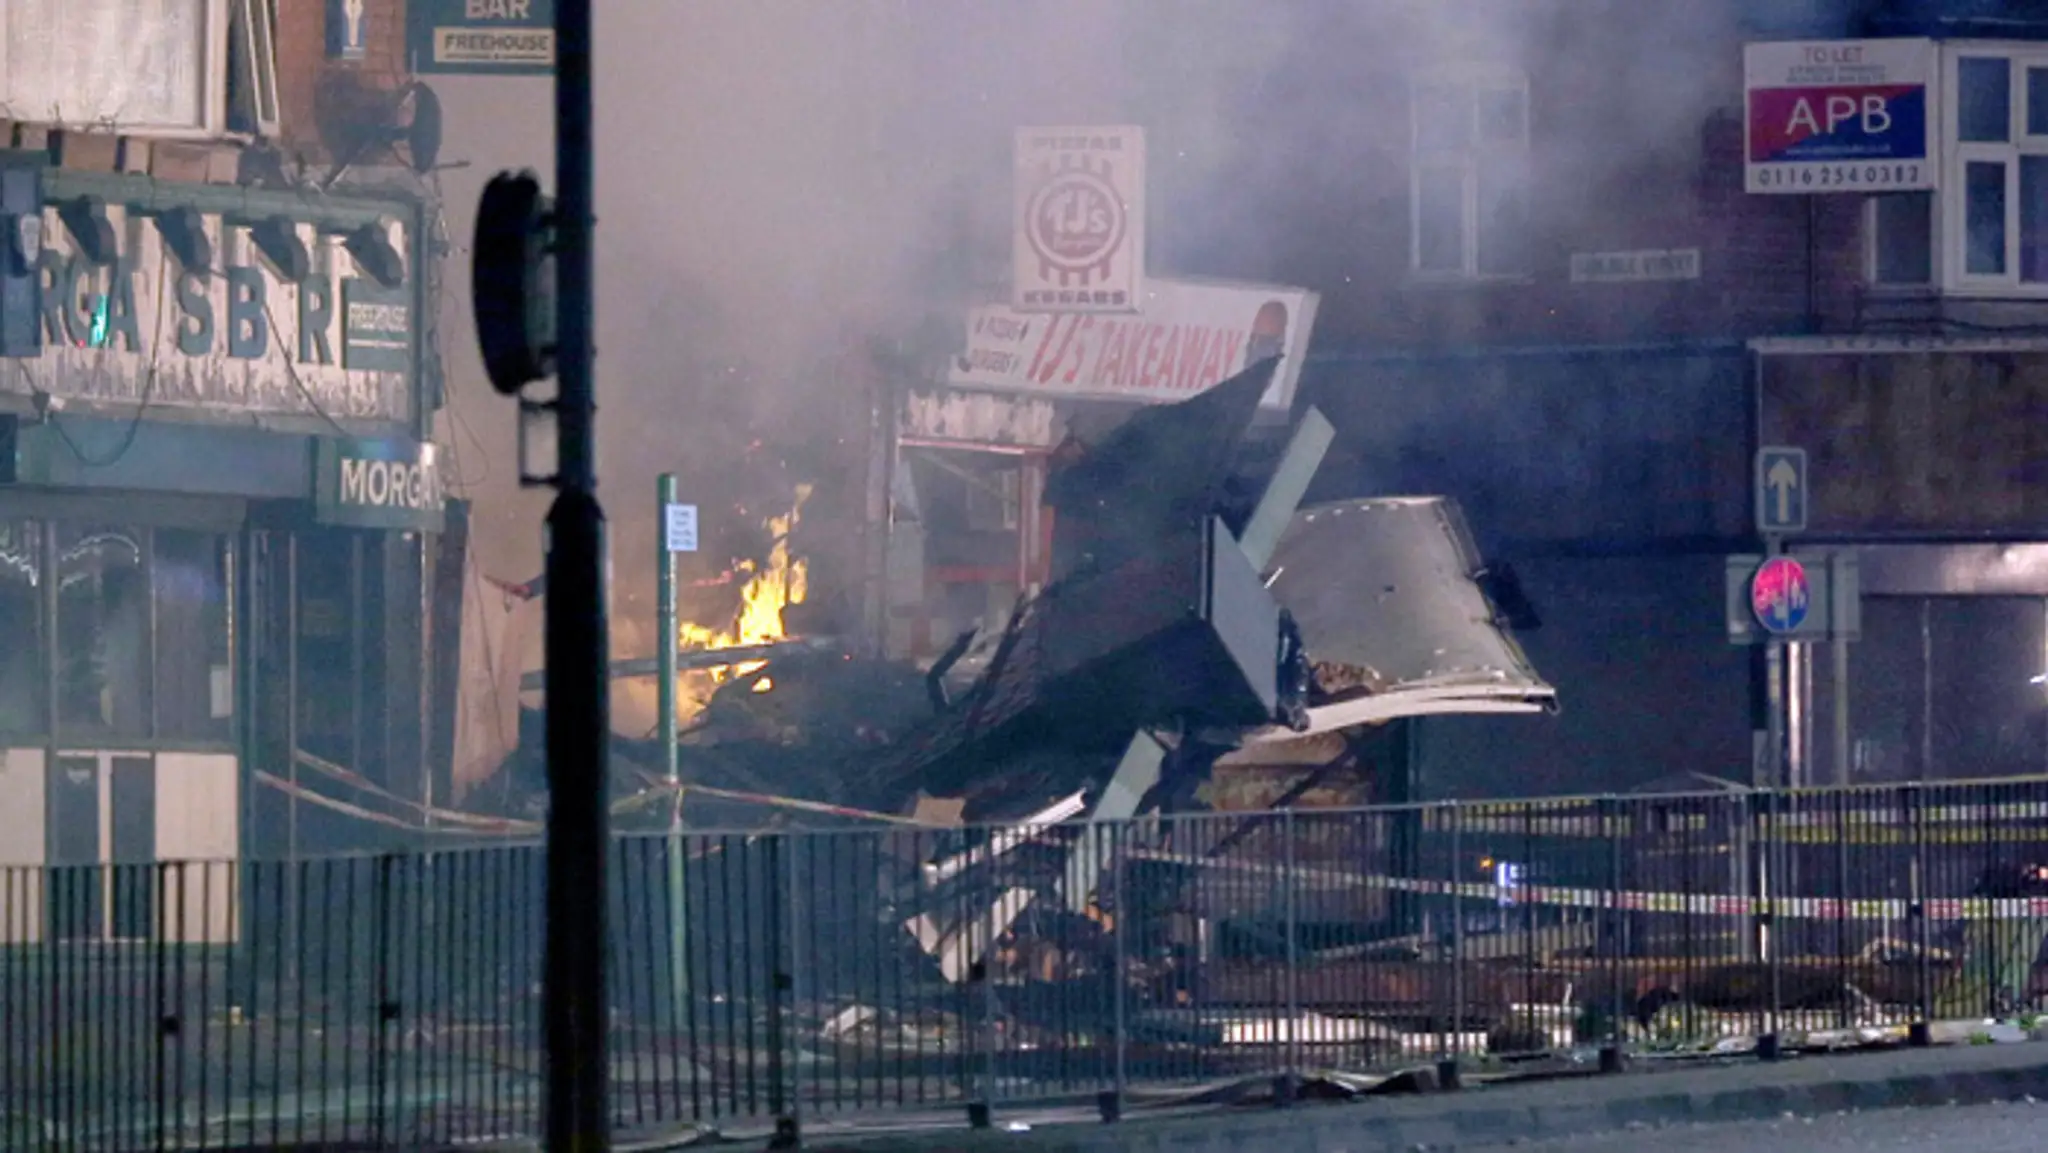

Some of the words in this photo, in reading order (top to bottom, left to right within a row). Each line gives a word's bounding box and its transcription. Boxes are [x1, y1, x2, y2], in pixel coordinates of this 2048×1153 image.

[465, 0, 531, 20] BAR
[444, 33, 549, 51] FREEHOUSE
[1803, 47, 1827, 64] TO
[1832, 46, 1865, 63] LET
[1784, 94, 1892, 136] APB
[1092, 320, 1246, 390] TAKEAWAY
